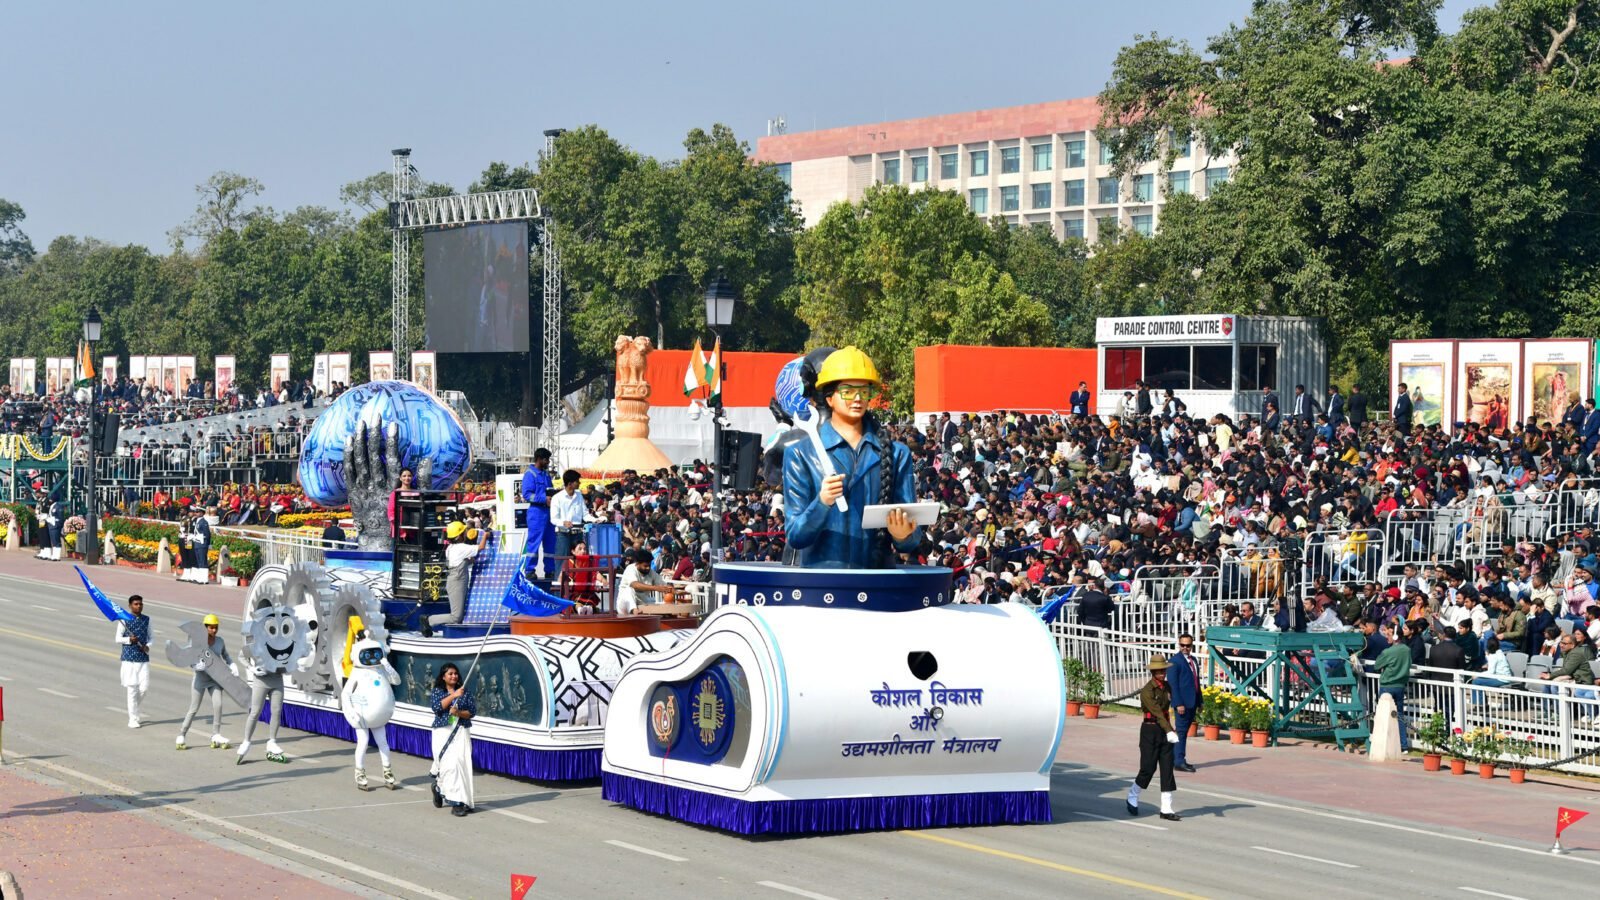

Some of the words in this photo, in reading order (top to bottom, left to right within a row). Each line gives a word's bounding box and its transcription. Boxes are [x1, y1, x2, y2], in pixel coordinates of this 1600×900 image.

[1114, 322, 1146, 336] PARADE
[1148, 320, 1184, 335] CONTROL
[1187, 320, 1219, 335] CENTRE
[870, 682, 922, 707] कौशल
[929, 681, 983, 706] विकास
[909, 708, 938, 731] और
[841, 734, 935, 757] उद्यमशीलता
[942, 736, 1001, 754] मंत्रालय
